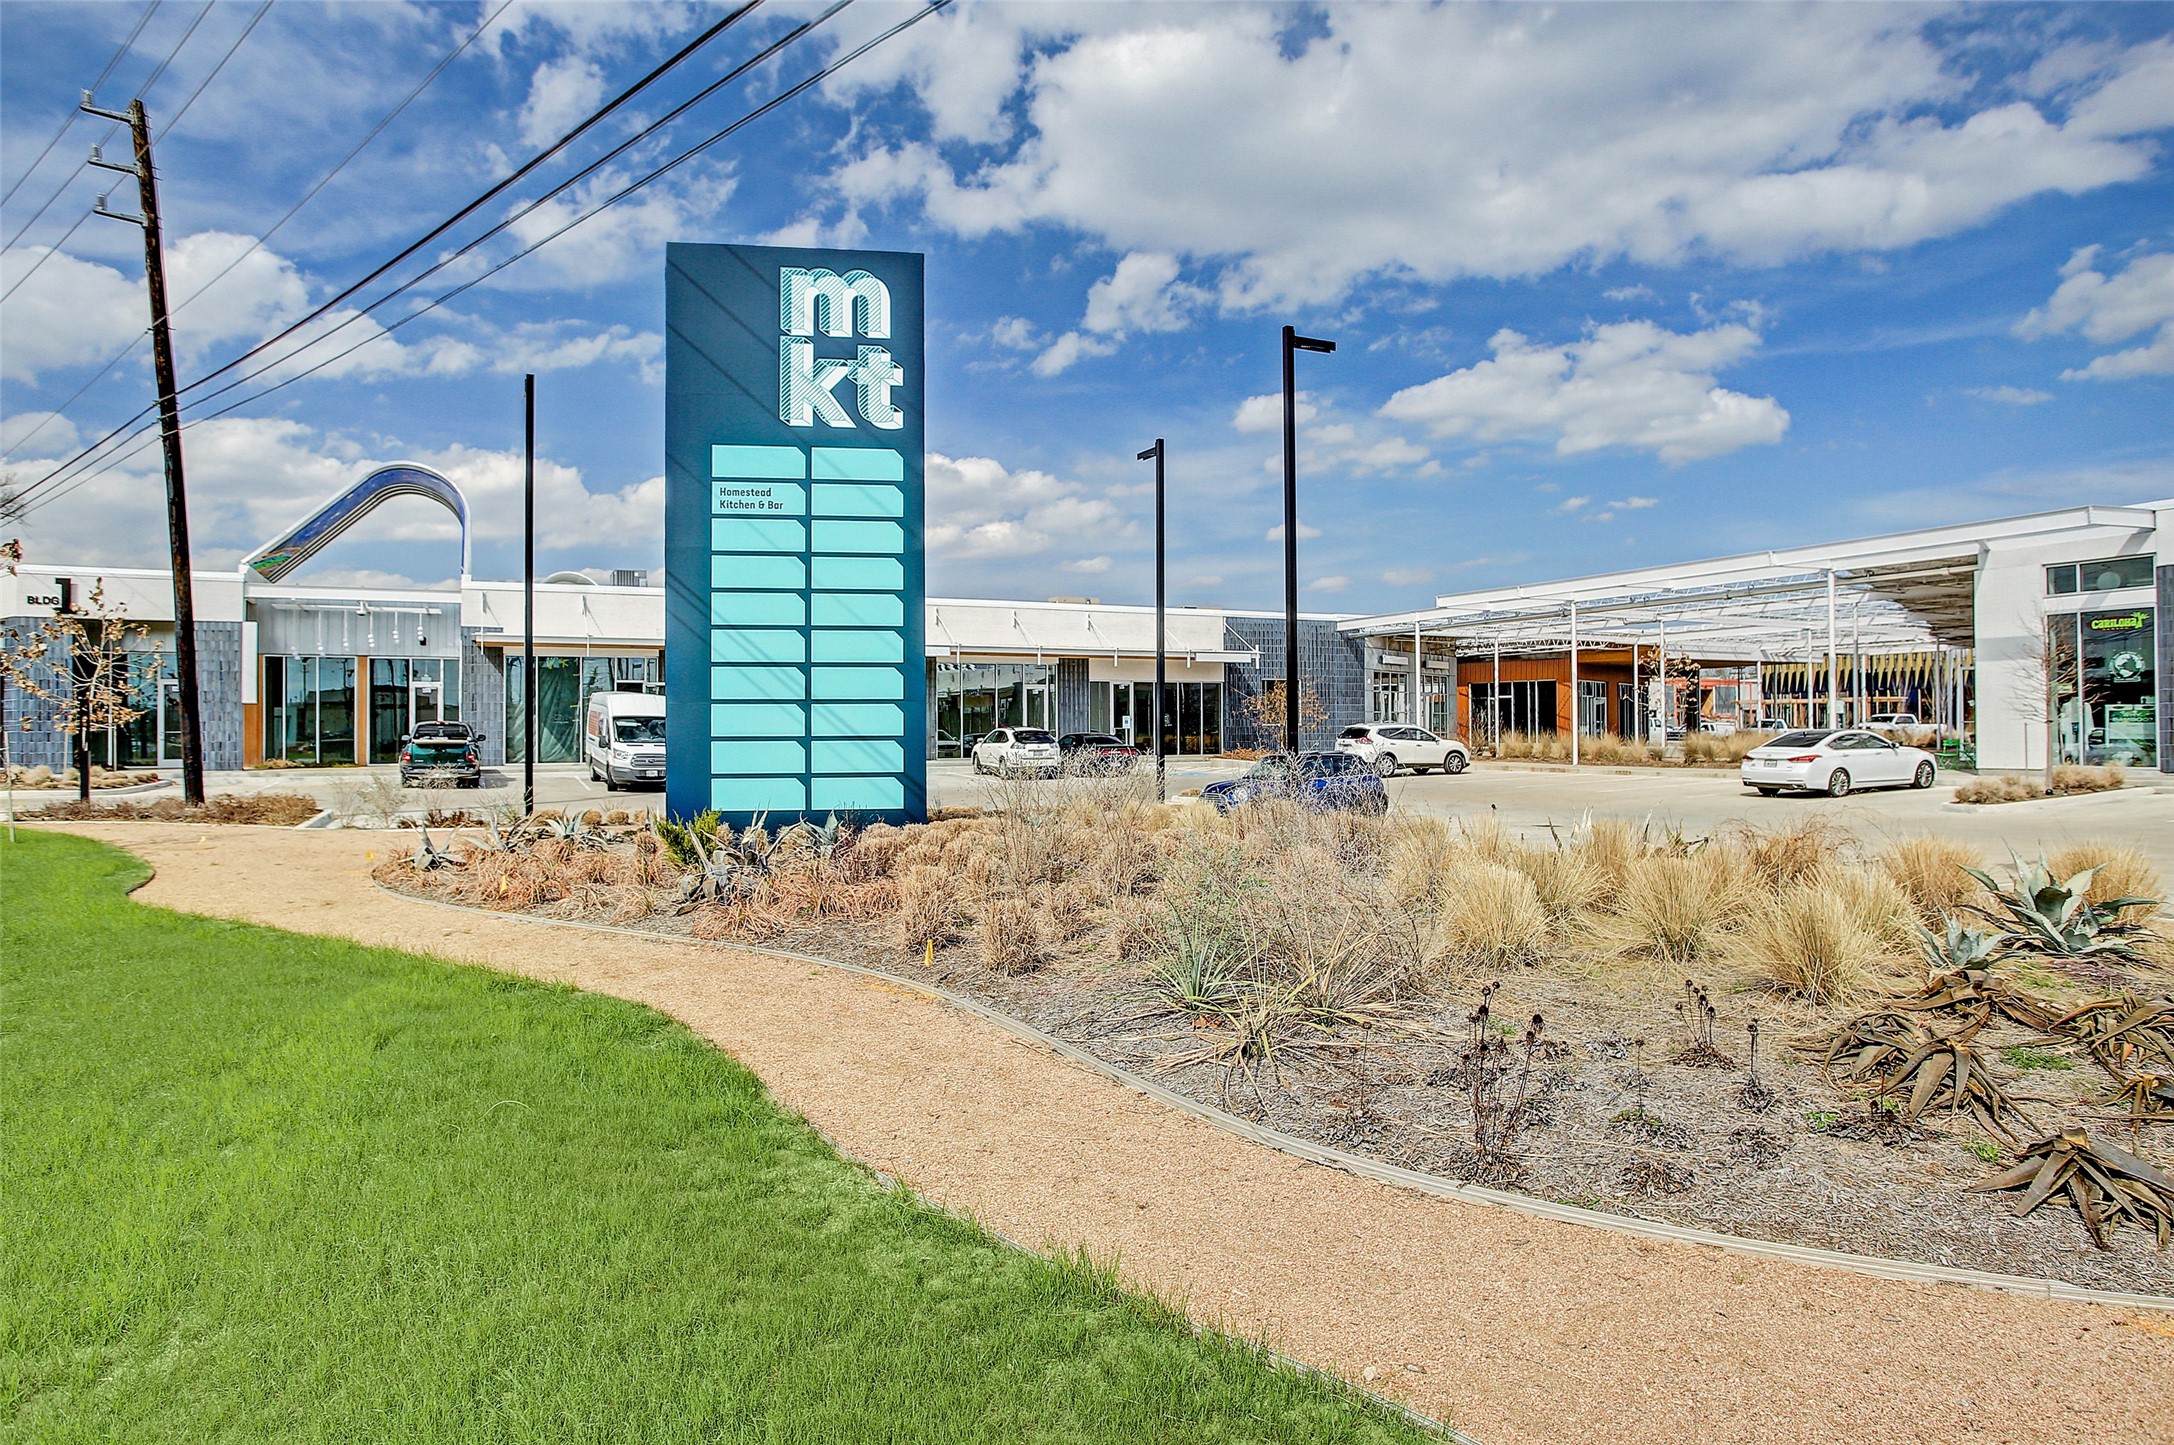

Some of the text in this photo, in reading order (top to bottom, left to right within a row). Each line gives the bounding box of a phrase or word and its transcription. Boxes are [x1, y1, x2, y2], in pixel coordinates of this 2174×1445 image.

[779, 266, 892, 339] m
[779, 335, 904, 430] kt
[719, 487, 772, 497] Homestead
[719, 499, 784, 510] Kitchen & Bar
[27, 577, 77, 614] BLDG 1
